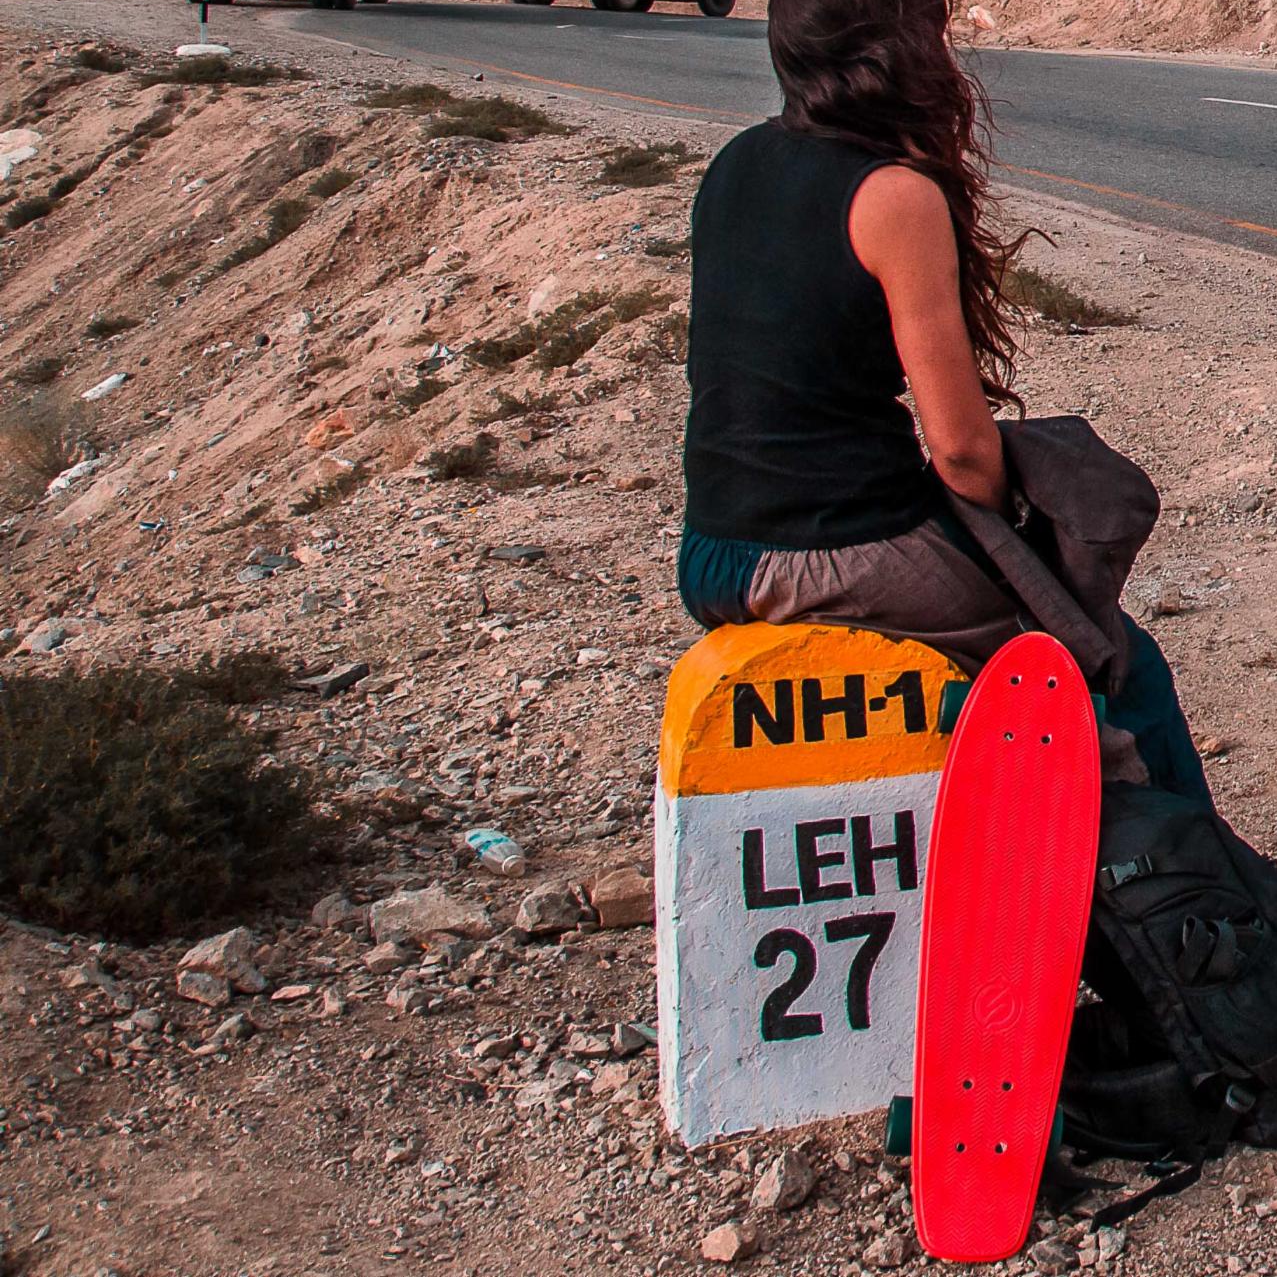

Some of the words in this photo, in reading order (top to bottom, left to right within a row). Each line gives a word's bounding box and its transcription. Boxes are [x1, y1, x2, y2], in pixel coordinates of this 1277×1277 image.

[732, 670, 928, 749] NH-1
[742, 809, 919, 911] LEH
[752, 911, 897, 1043] 27
